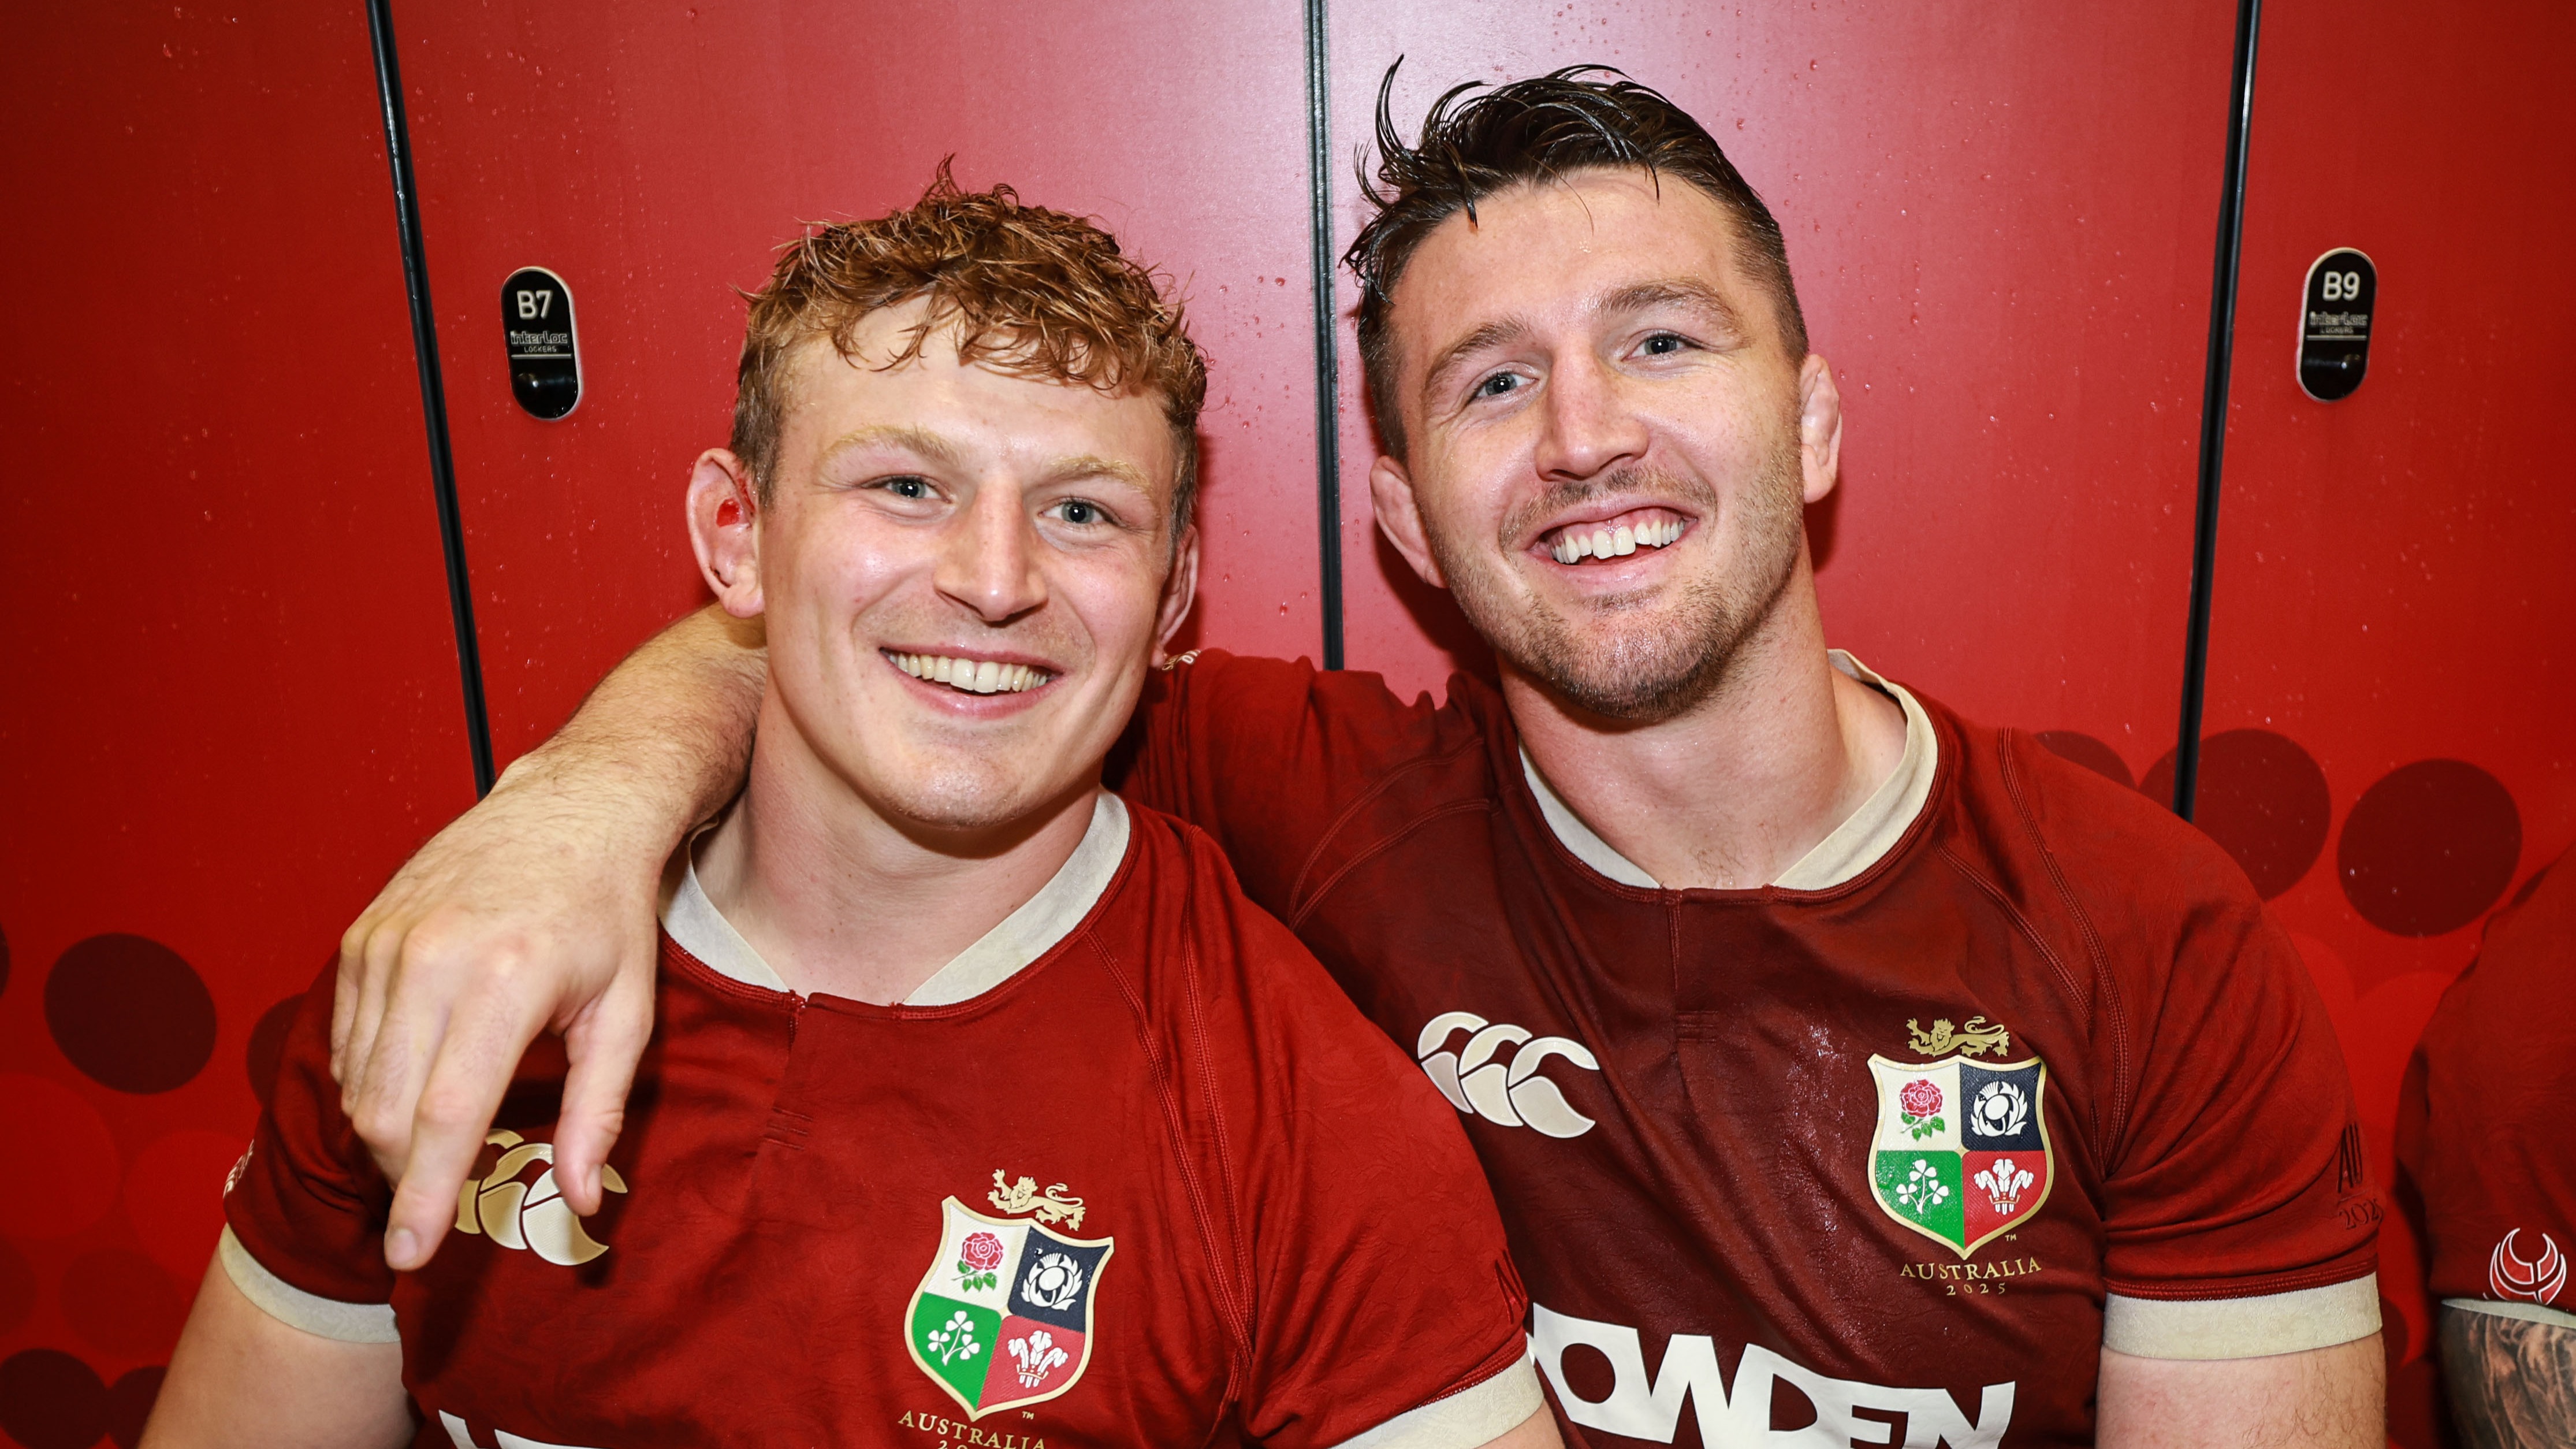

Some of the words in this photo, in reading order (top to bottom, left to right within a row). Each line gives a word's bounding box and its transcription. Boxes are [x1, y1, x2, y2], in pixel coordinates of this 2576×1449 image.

[2322, 270, 2361, 302] B9
[516, 289, 553, 319] B7
[1899, 1256, 2042, 1280] AUSTRALIA
[1946, 1282, 2006, 1296] 2025
[898, 1410, 1045, 1449] AUSTRALIA
